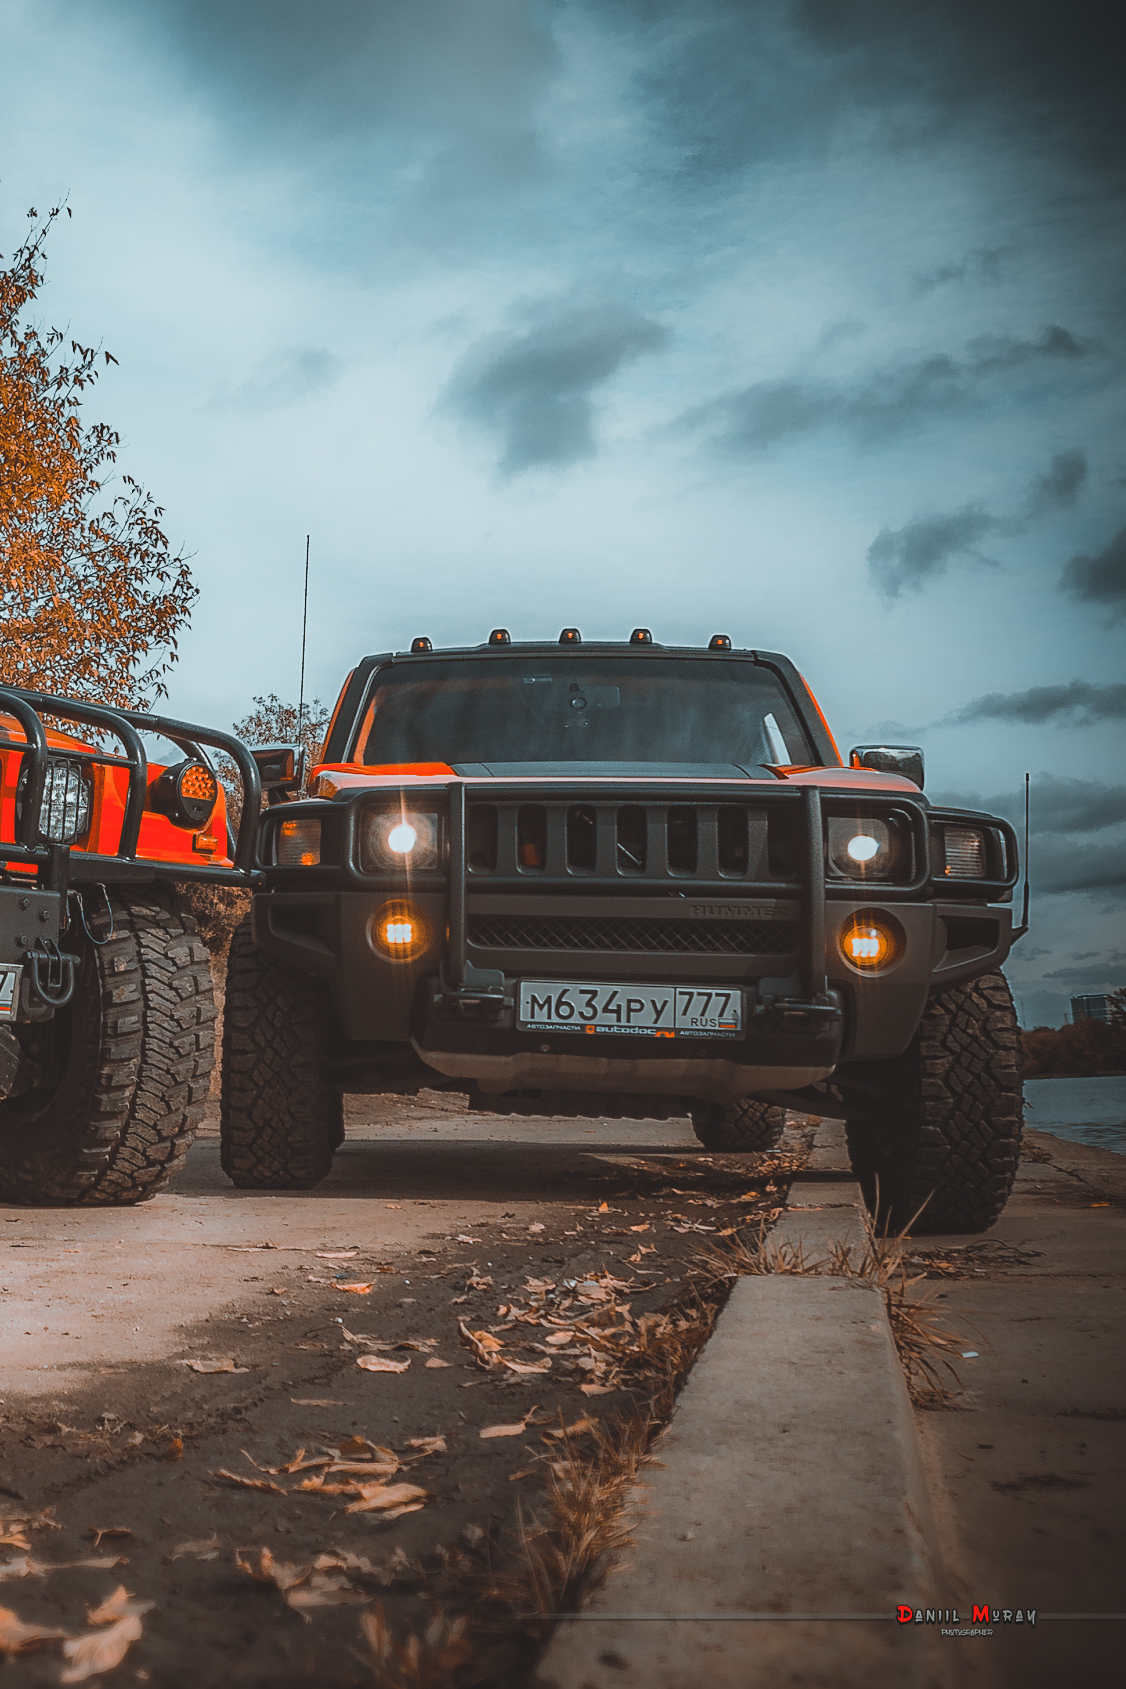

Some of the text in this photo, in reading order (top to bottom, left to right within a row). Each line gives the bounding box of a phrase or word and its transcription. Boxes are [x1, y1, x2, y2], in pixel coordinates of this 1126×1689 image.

[690, 904, 791, 918] HUMMER
[678, 991, 731, 1017] 777
[690, 1017, 717, 1028] RUS
